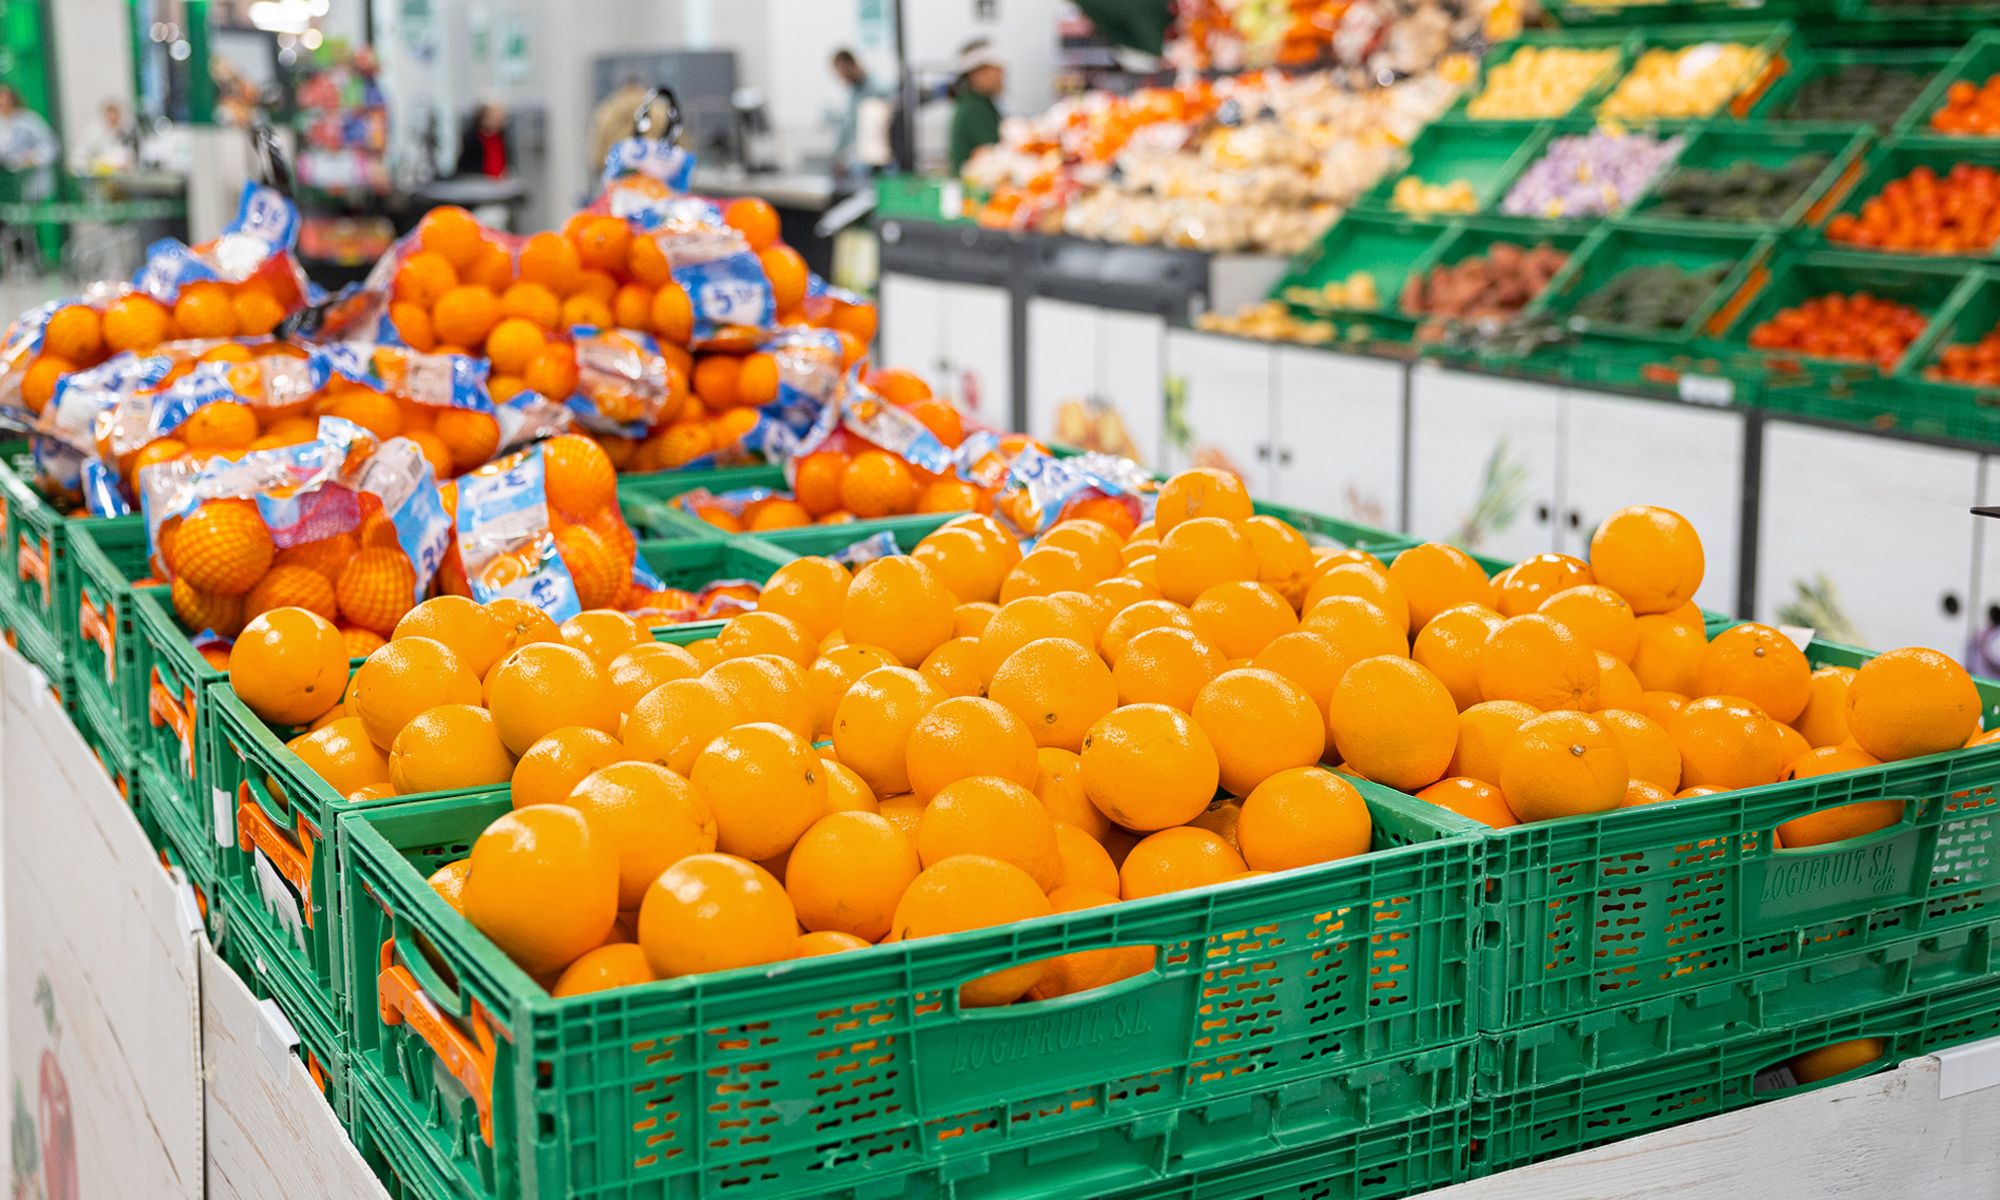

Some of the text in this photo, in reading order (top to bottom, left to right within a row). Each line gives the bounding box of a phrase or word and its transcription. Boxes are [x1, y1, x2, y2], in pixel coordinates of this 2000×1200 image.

[1760, 850, 1866, 903] LOGIFRUIT,
[951, 998, 1152, 1073] LOGIFRUIT, S.L.
